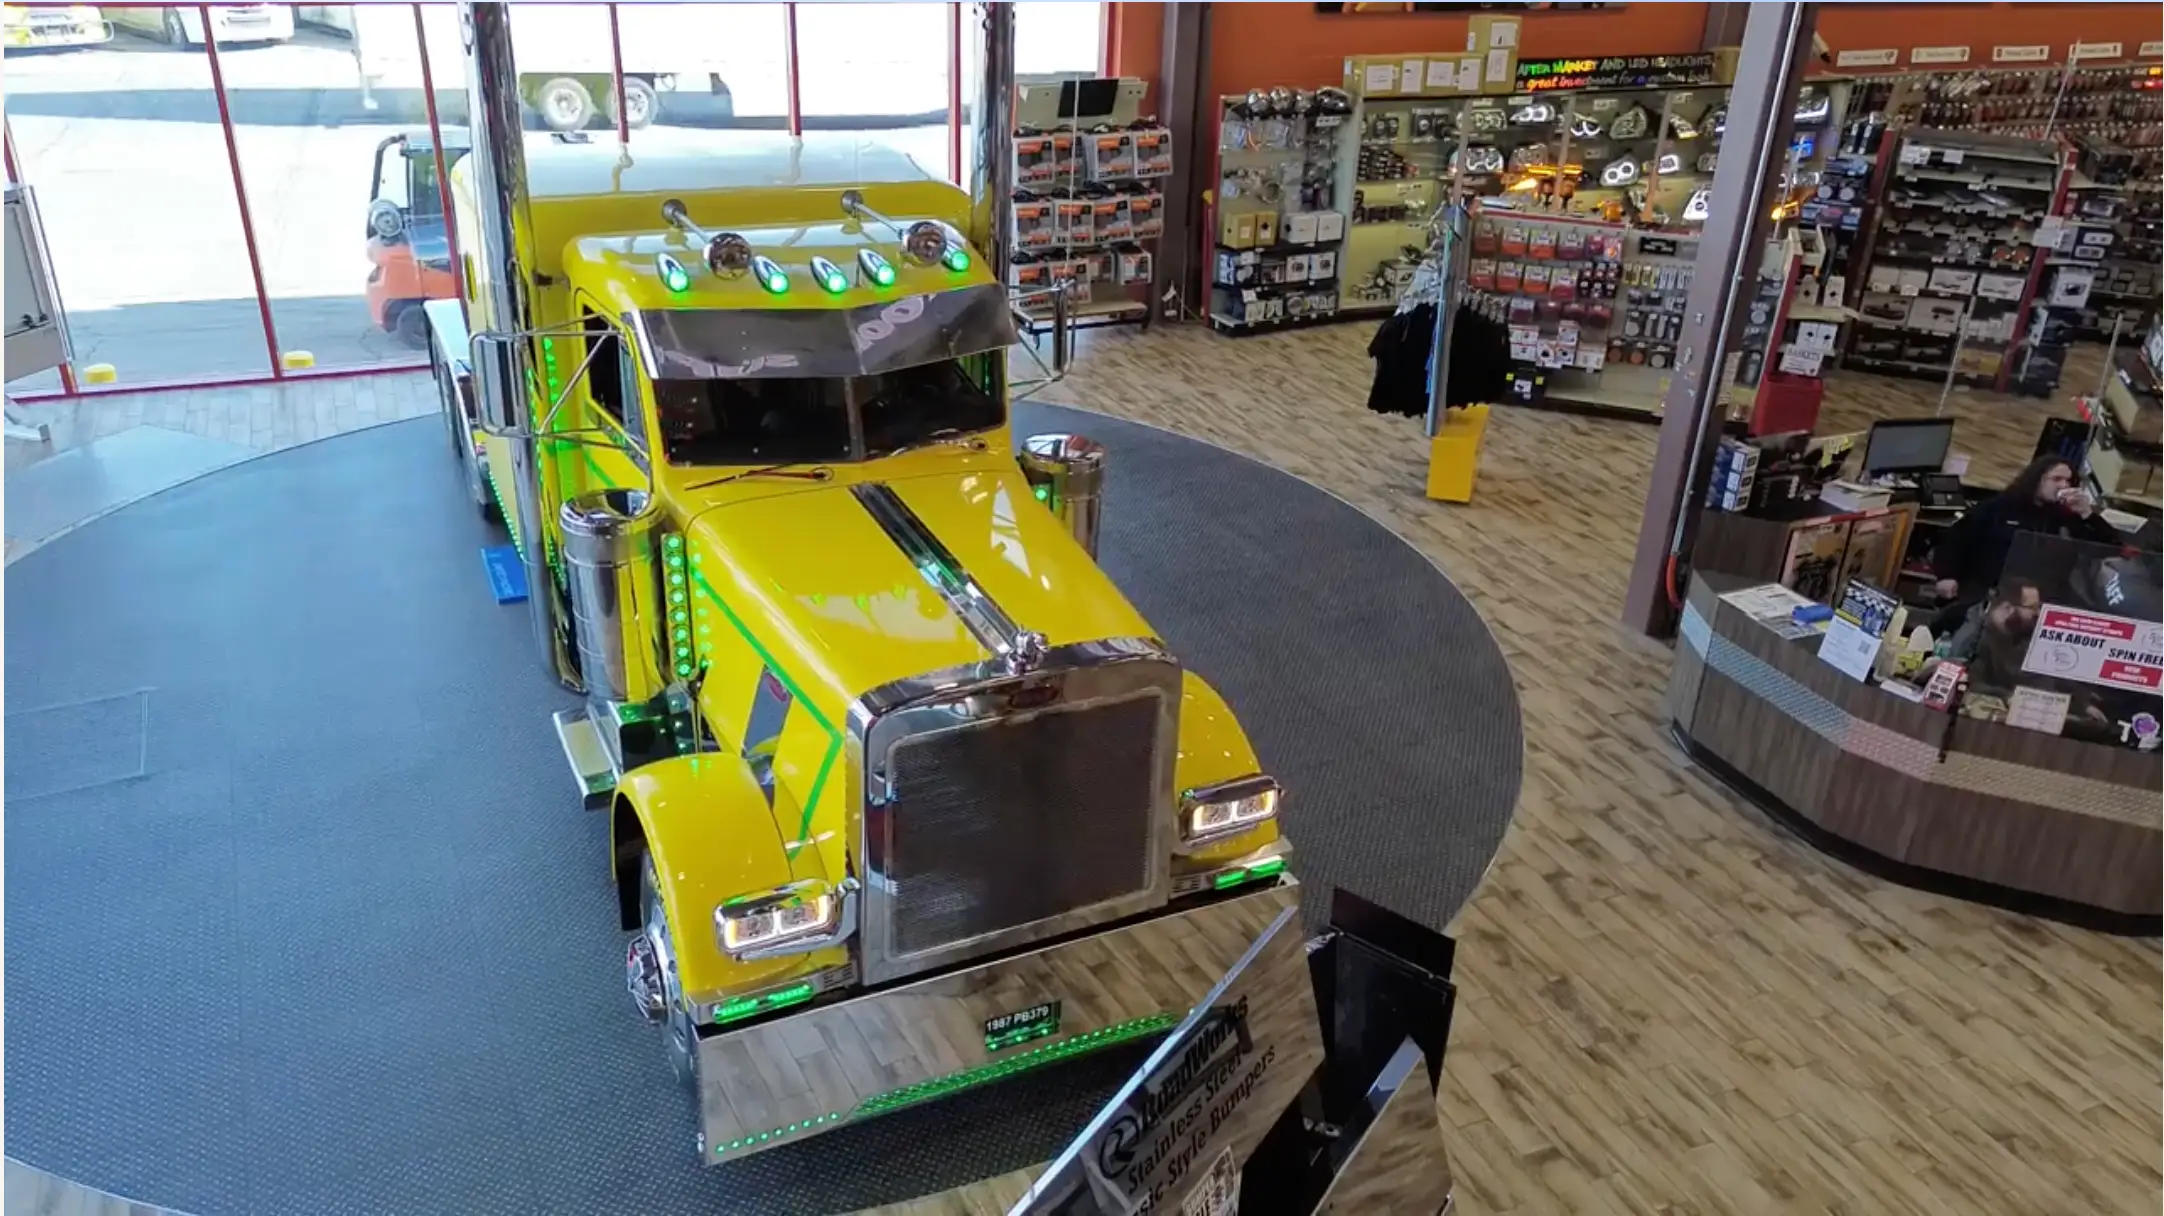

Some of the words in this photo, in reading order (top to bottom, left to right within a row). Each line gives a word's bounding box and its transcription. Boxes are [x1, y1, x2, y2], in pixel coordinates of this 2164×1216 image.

[1517, 63, 1551, 77] AFTER
[1552, 60, 1597, 74] MARKET
[1600, 57, 1626, 71] AND
[1628, 57, 1649, 69] LED
[1526, 76, 1558, 92] great
[1559, 74, 1618, 88] investment
[1619, 70, 1636, 85] for
[2040, 629, 2064, 642] ASK
[2065, 635, 2106, 649] ABOUT
[2108, 647, 2137, 661] SPIN
[987, 1016, 1012, 1031] 1987
[1014, 1006, 1049, 1024] PB379
[1141, 995, 1248, 1132] RoadWorks
[1127, 1100, 1203, 1196] Stainless
[1205, 1053, 1243, 1100] Steel
[1167, 1129, 1207, 1187] Style
[1209, 1044, 1276, 1136] Bumpers
